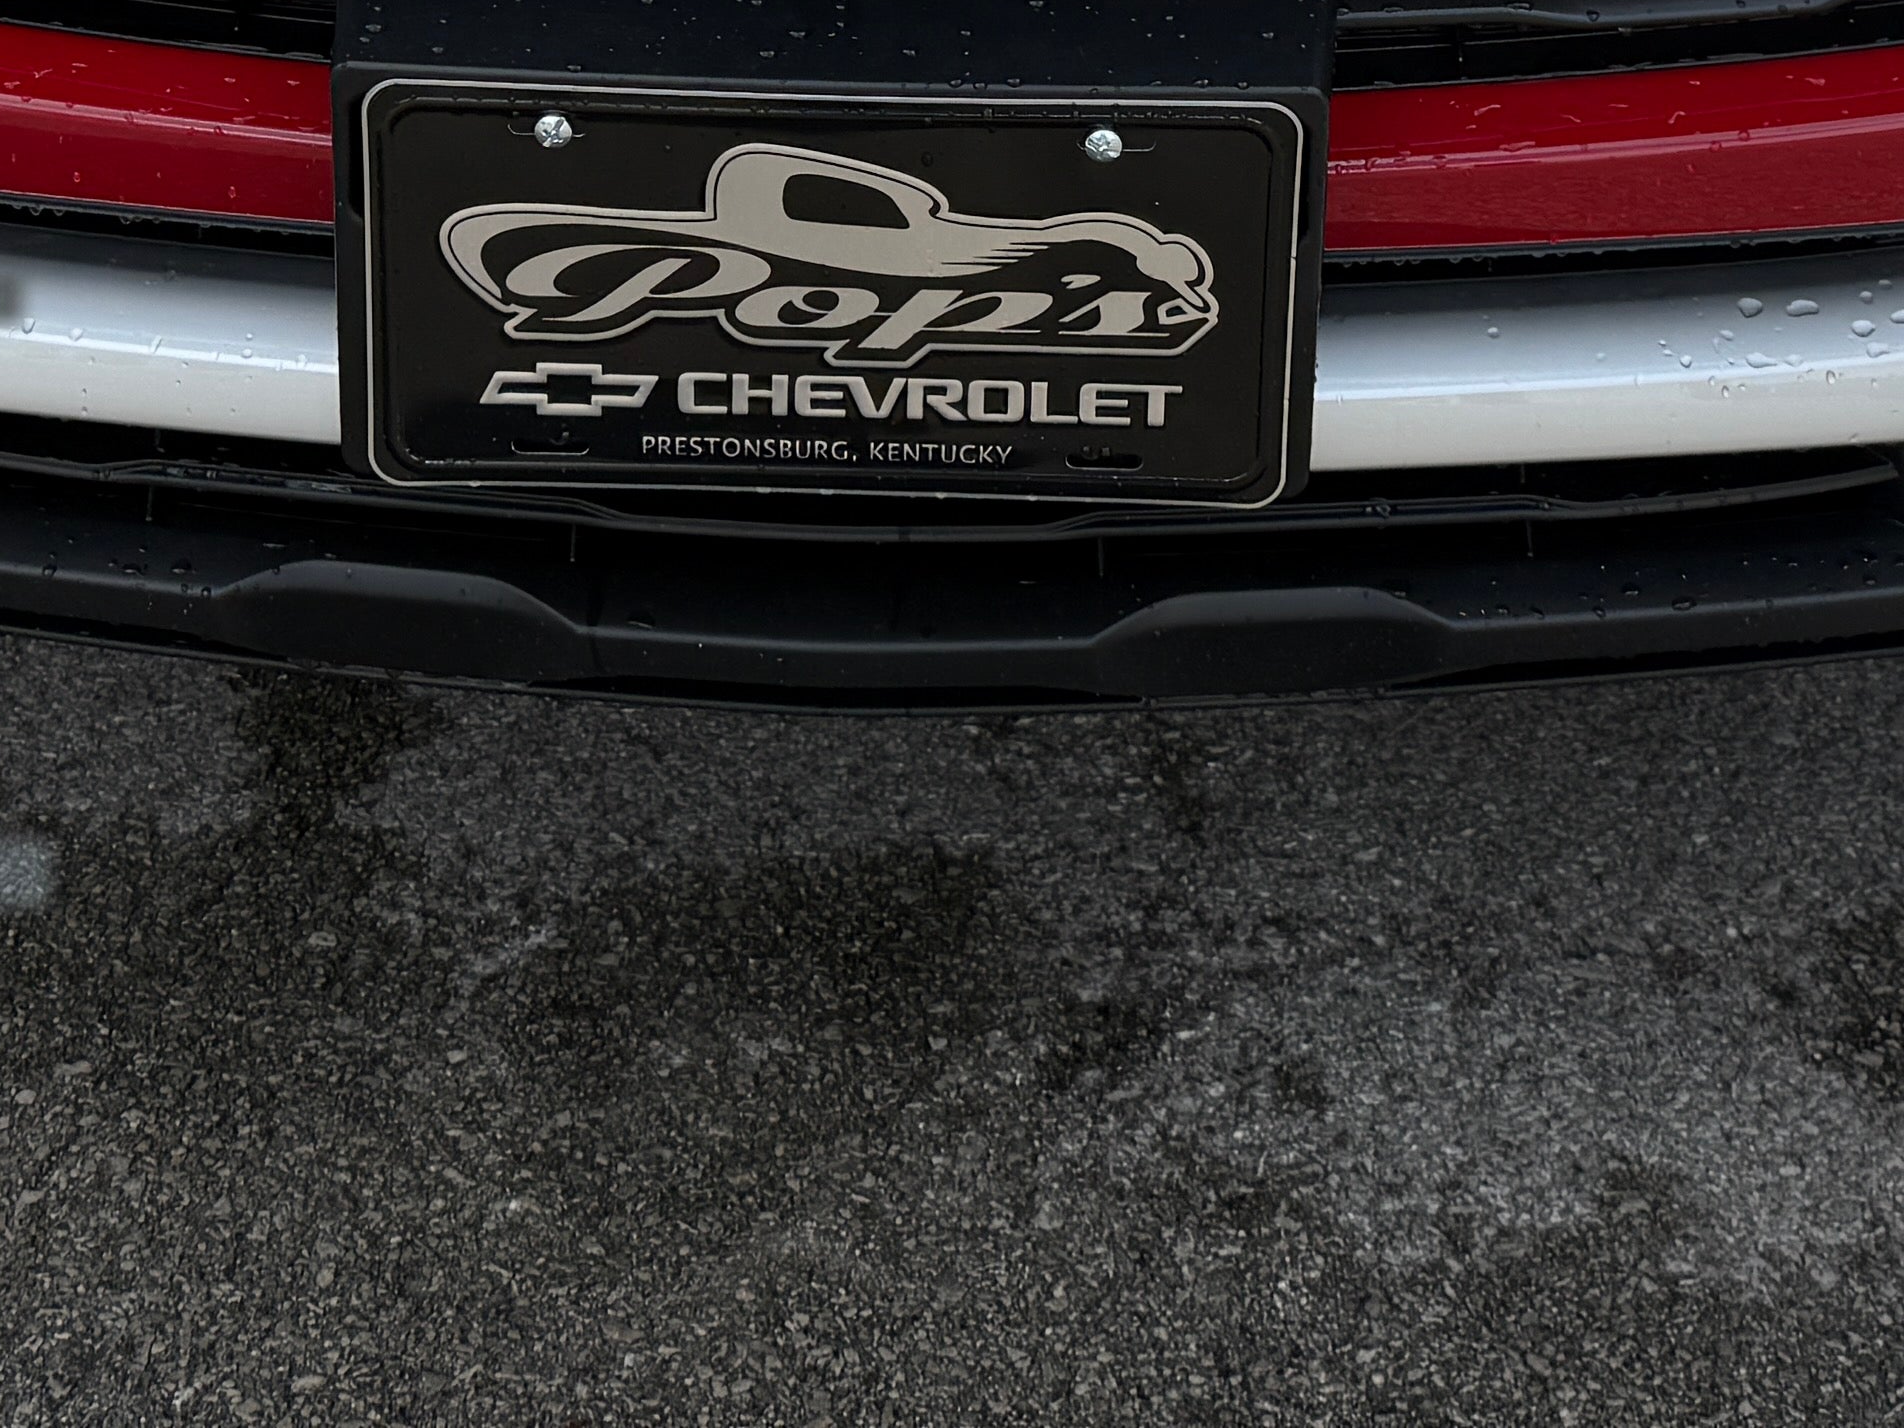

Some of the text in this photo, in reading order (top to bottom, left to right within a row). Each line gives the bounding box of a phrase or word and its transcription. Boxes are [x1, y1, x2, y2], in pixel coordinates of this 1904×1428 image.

[504, 243, 1172, 350] Pop's
[677, 371, 1183, 427] CHEVROLET
[641, 435, 1013, 465] PRESTONSBURG, KENTUCKY
